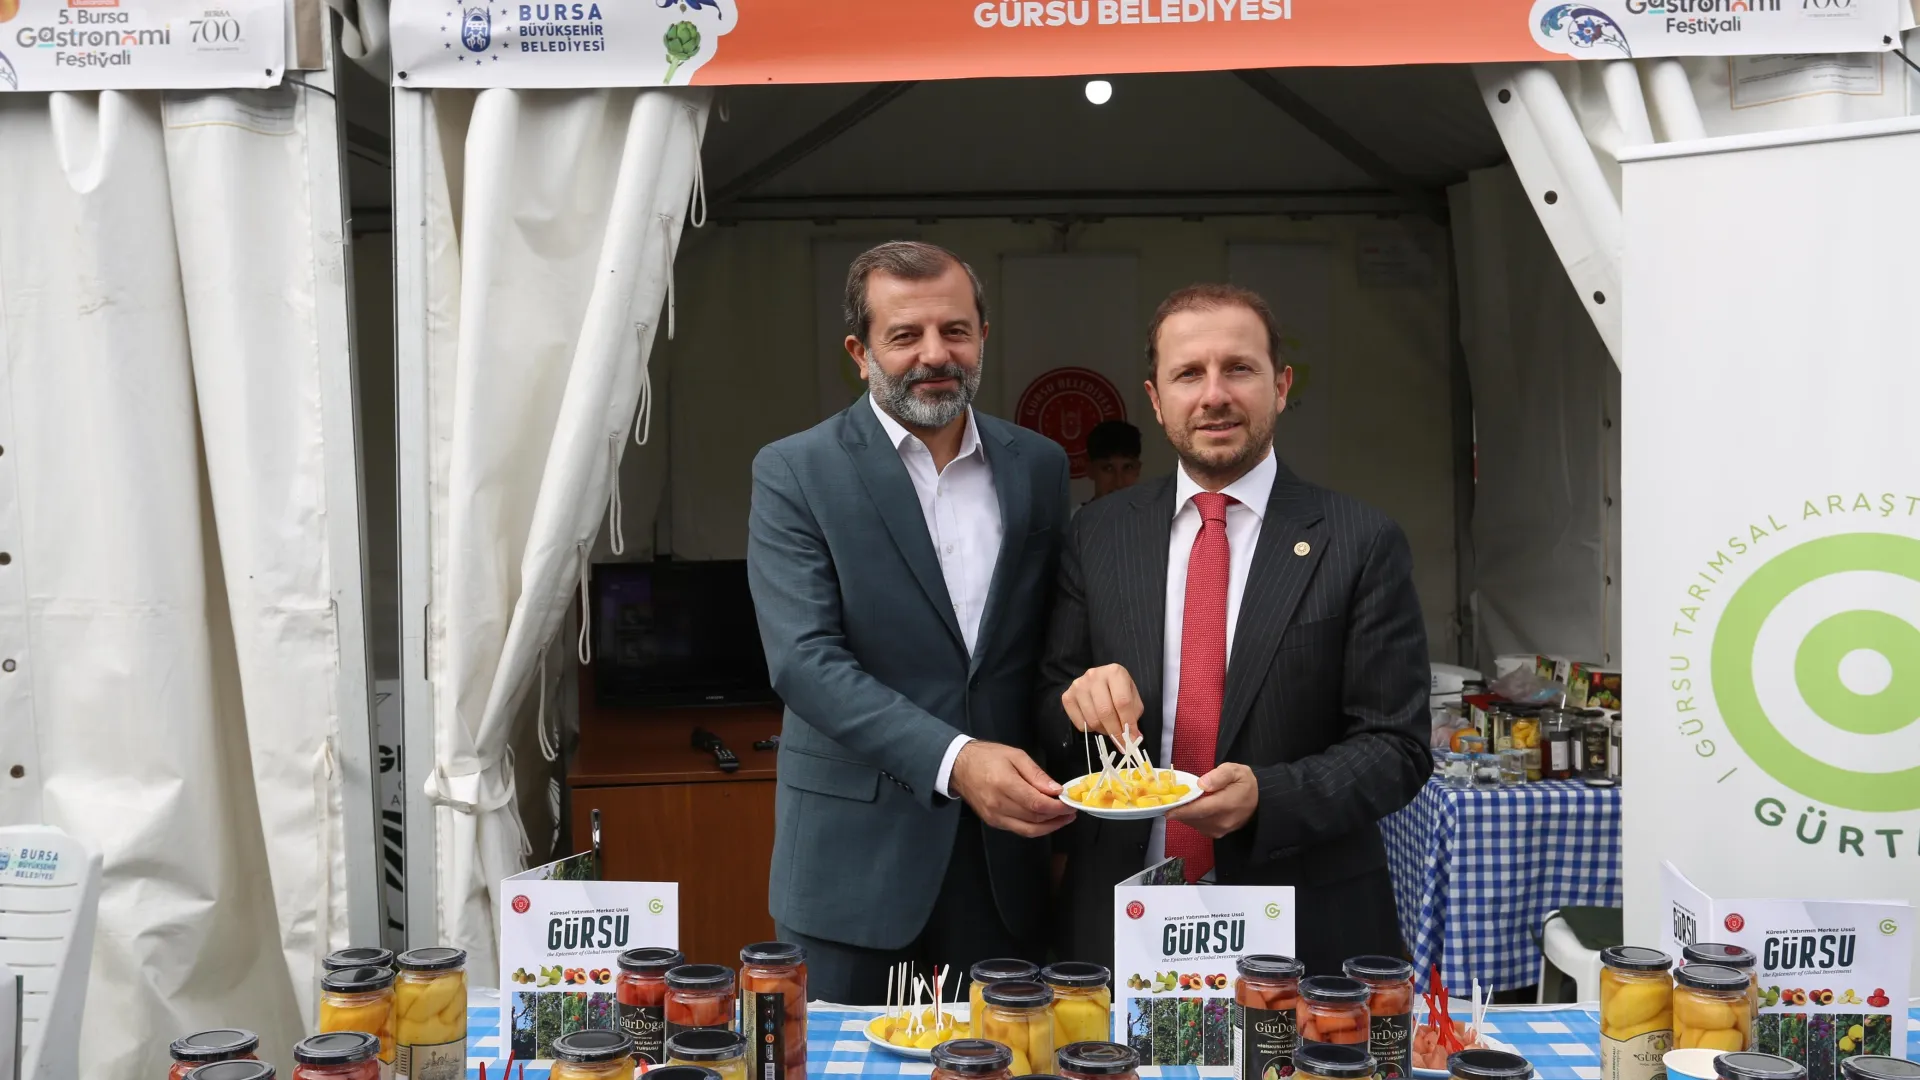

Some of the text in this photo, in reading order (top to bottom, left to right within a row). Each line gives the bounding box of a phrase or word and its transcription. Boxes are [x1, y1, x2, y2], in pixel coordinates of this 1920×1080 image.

[58, 9, 129, 24] 5. Bursa
[519, 3, 602, 20] BURSA
[973, 0, 1089, 28] GÜRSU
[16, 24, 170, 48] Gastronomi
[189, 19, 240, 43] 700
[519, 22, 603, 38] BÜYÜKŞEHİR
[1667, 16, 1741, 35] Festivali
[521, 37, 604, 52] BELEDİYESİ
[56, 50, 131, 68] Festivali
[1673, 515, 1788, 638] TARIMSAL
[1670, 655, 1716, 758] GÜRSU
[1754, 797, 1920, 859] GÜRT
[20, 848, 59, 861] BURSA
[548, 915, 629, 950] GÜRSU
[1163, 920, 1245, 956] GÜRSU
[1763, 935, 1856, 970] GÜRSU
